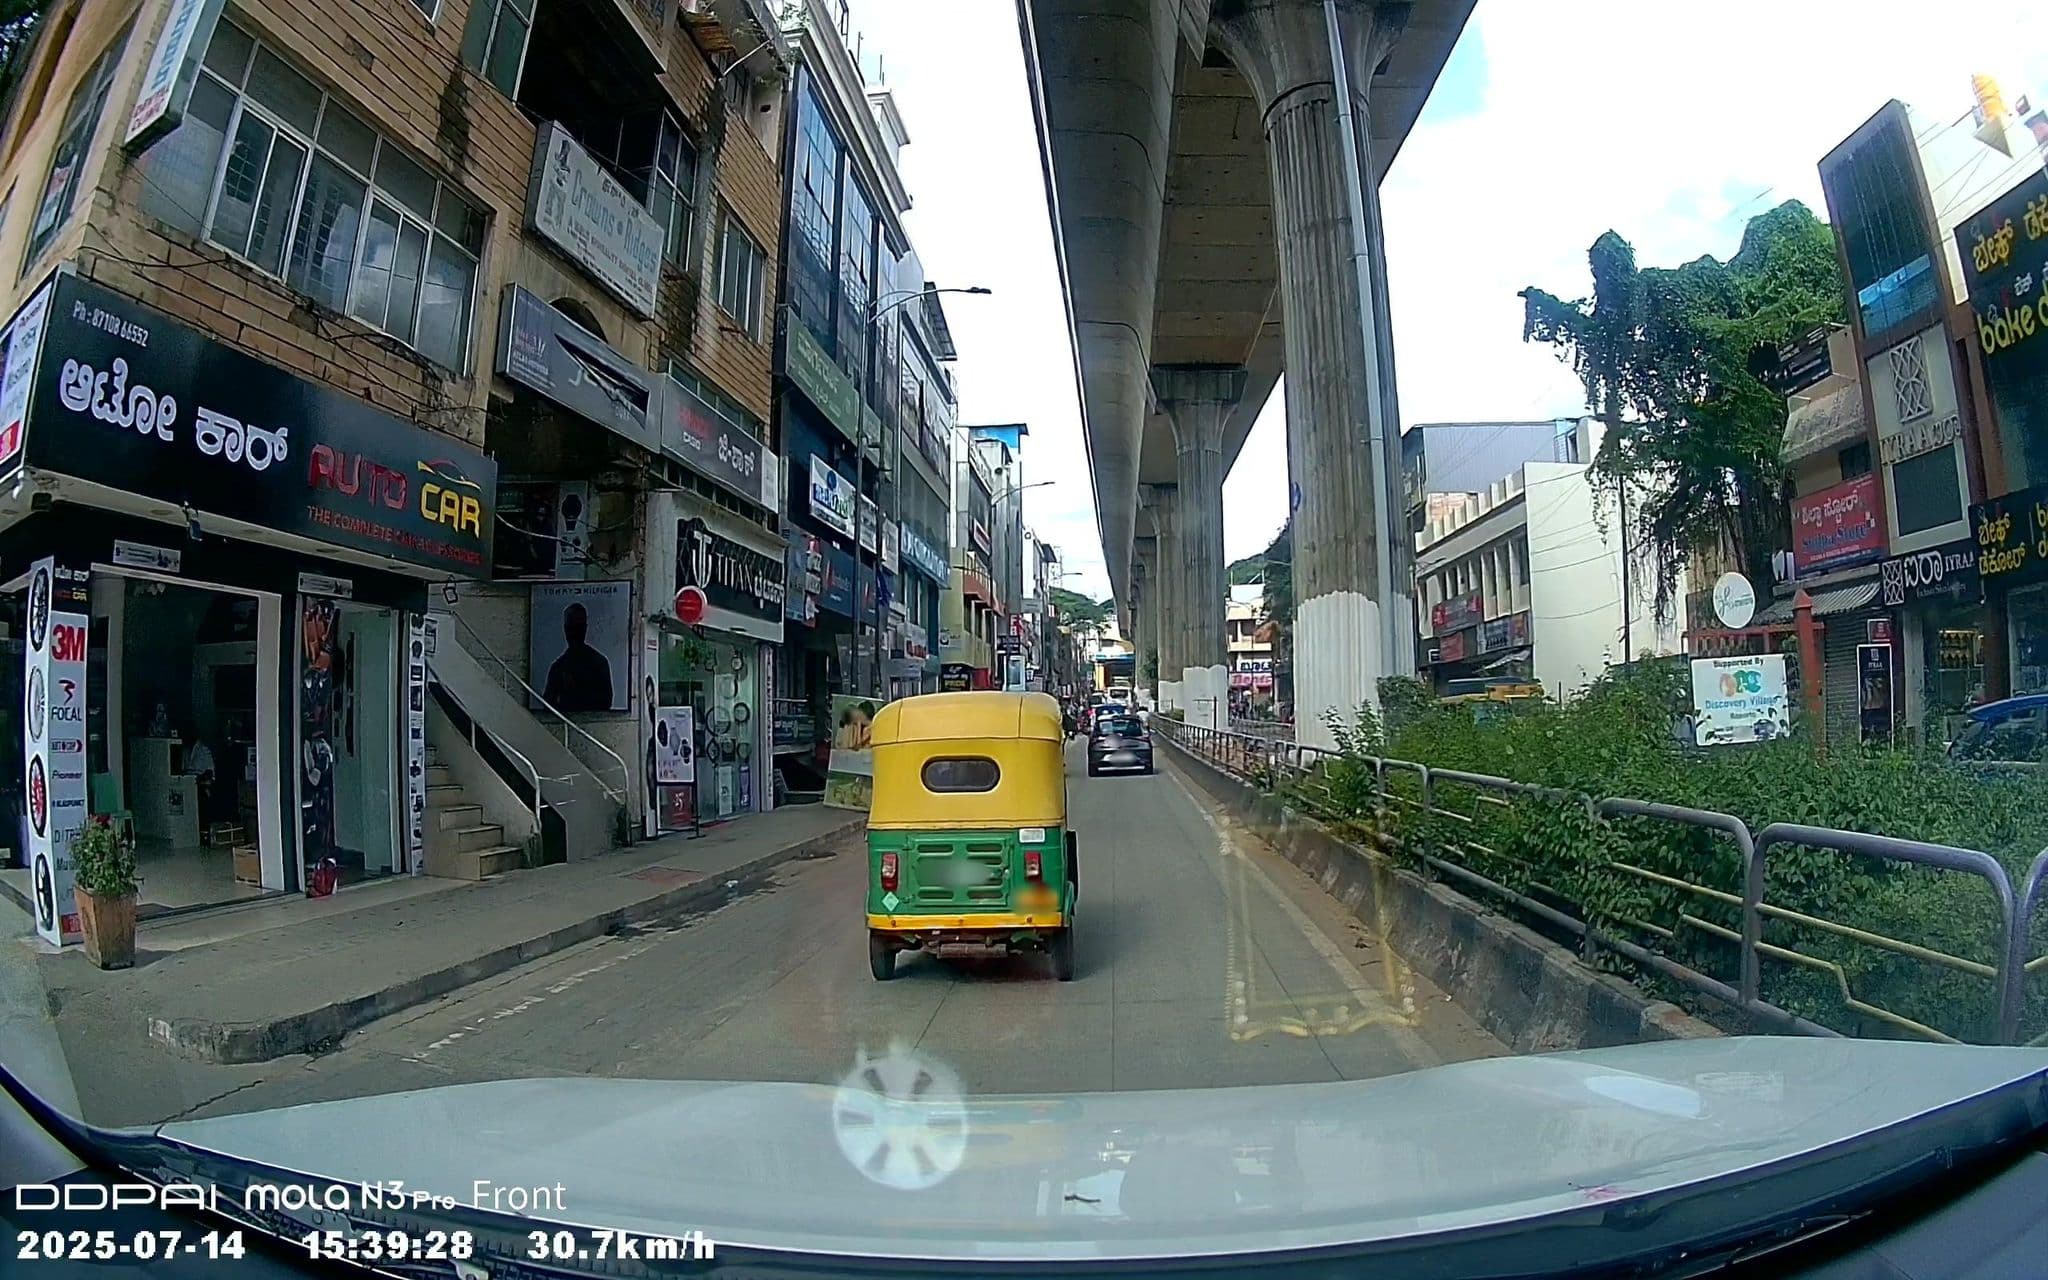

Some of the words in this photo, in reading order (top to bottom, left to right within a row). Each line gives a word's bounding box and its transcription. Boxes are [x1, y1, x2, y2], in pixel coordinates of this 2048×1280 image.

[1976, 304, 2035, 354] bake
[59, 357, 177, 442] ಆಟೋ
[196, 406, 289, 471] ಕಾರ್
[308, 443, 409, 510] AUTO
[421, 482, 481, 539] CAR
[307, 505, 332, 525] THE
[715, 552, 753, 593] TITAN
[51, 623, 86, 662] 3M
[51, 706, 83, 722] FOCAL
[1705, 699, 1748, 710] Discovery
